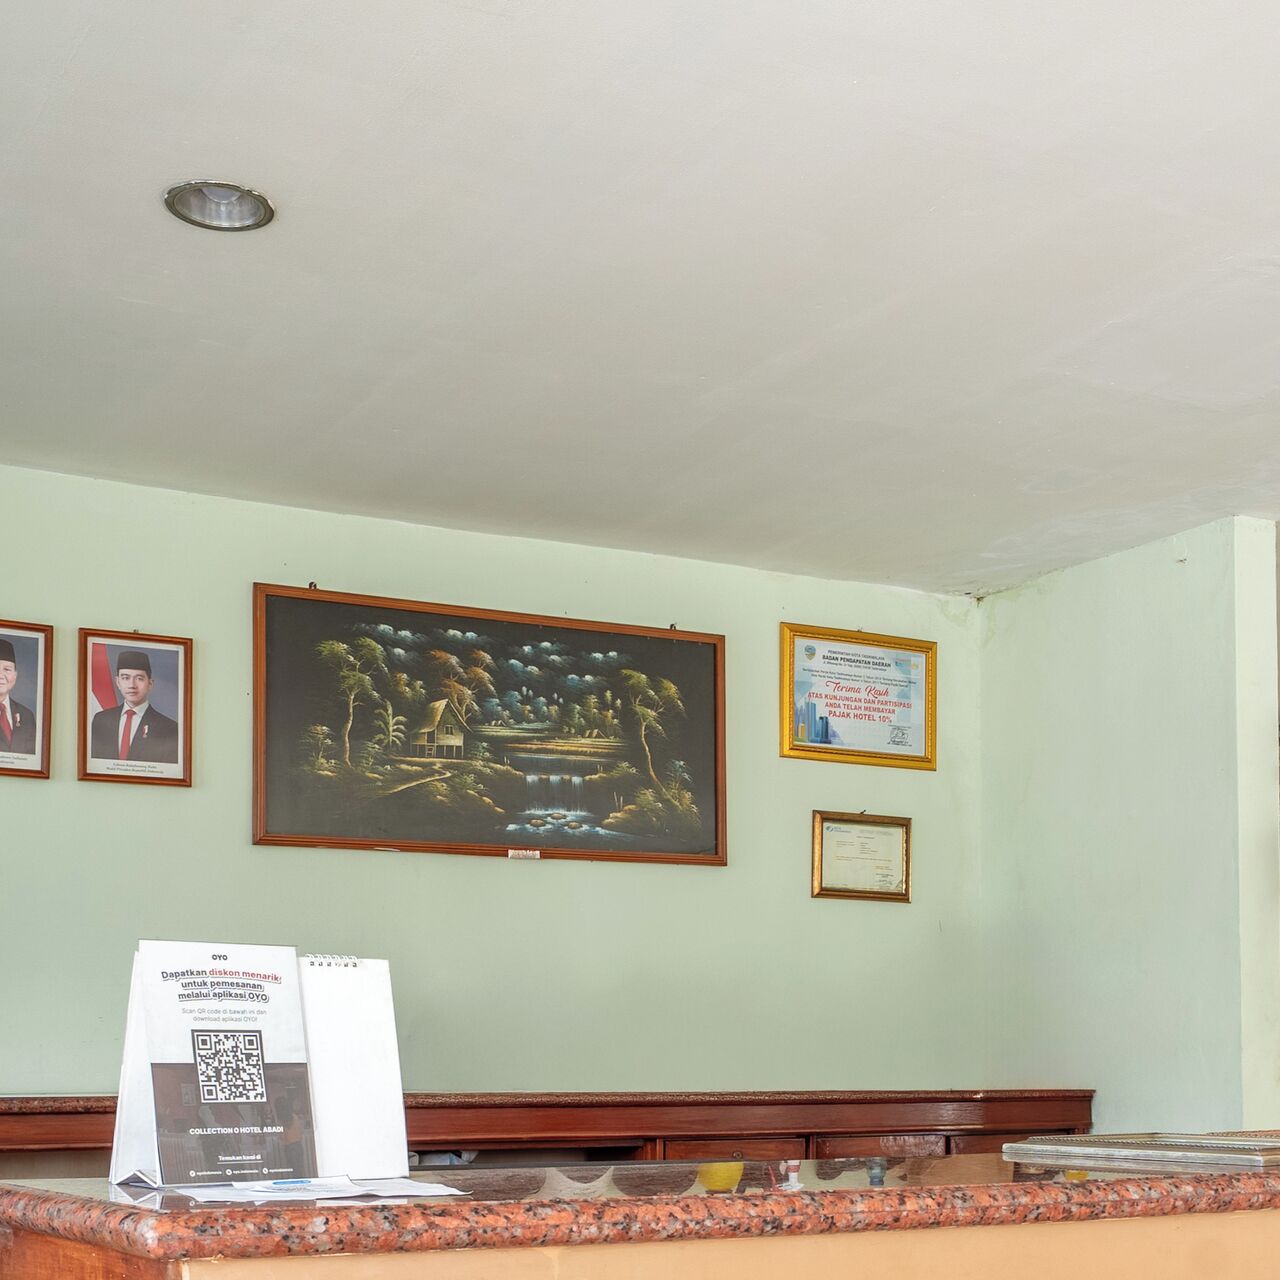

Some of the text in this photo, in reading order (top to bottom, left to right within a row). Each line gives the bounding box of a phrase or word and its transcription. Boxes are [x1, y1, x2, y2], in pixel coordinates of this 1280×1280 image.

[840, 657, 871, 666] PENDAPATAN
[872, 660, 892, 668] DAERAH
[826, 681, 889, 699] Terima Kasih
[824, 694, 862, 703] KUNJUNGAN
[876, 699, 912, 709] PARTISIPASI
[843, 704, 862, 712] TELAH
[863, 706, 896, 714] MEMBAYAR
[828, 710, 892, 724] PAJAK HOTEL 10%
[161, 969, 208, 980] Dapatkan
[209, 968, 240, 977] diskon
[181, 980, 263, 991] untuk pemesanan
[178, 991, 268, 1002] melalui aplikasi OYO
[190, 1127, 233, 1135] COLLECTION
